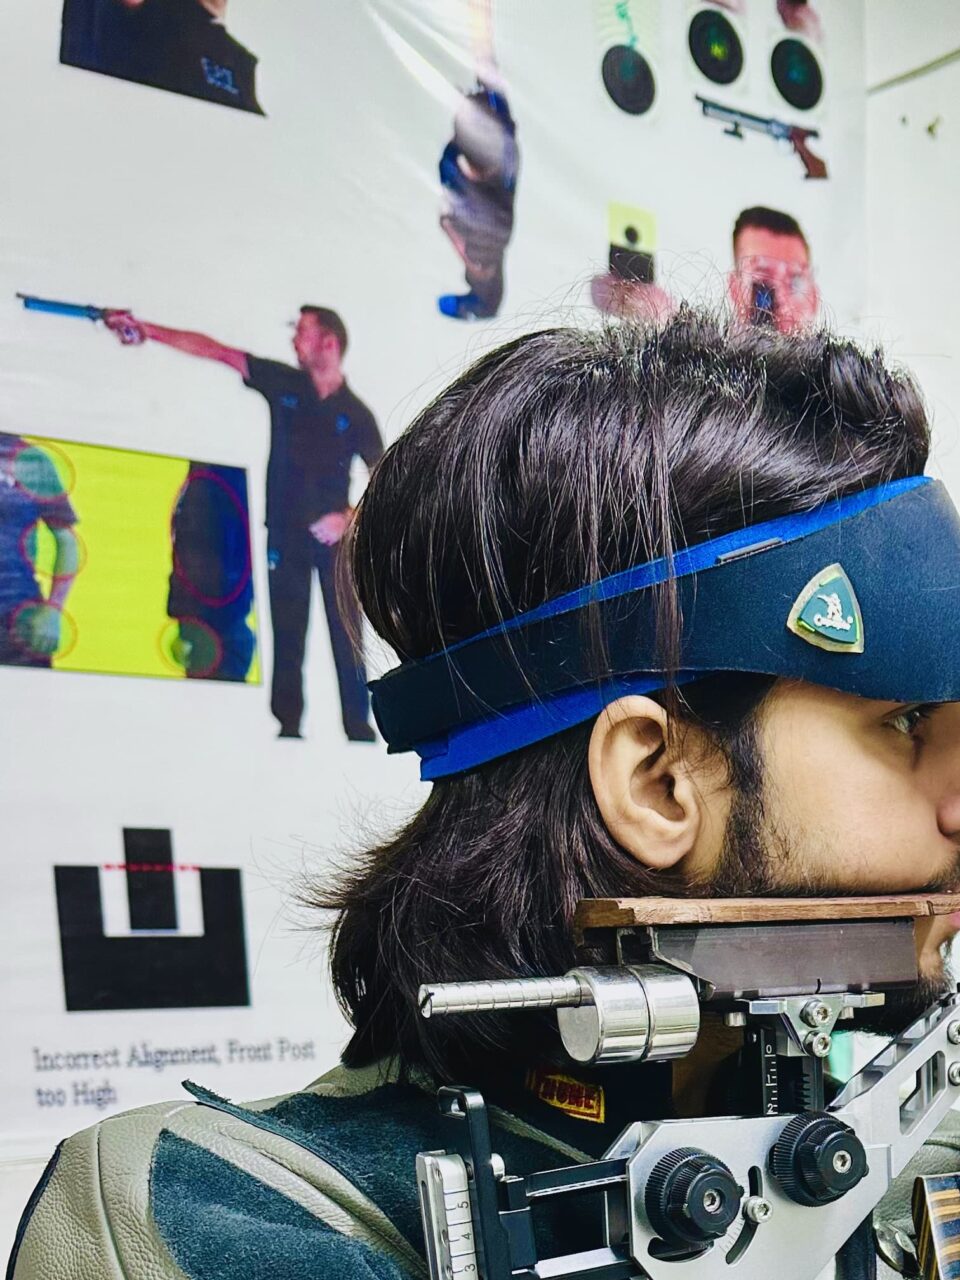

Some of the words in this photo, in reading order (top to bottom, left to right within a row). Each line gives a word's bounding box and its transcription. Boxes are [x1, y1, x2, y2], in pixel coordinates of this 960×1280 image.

[34, 1047, 120, 1071] Incorrect
[227, 1040, 272, 1063] Front
[277, 1038, 316, 1061] Post
[35, 1086, 66, 1106] too
[72, 1080, 118, 1110] High
[465, 1263, 475, 1272] 3
